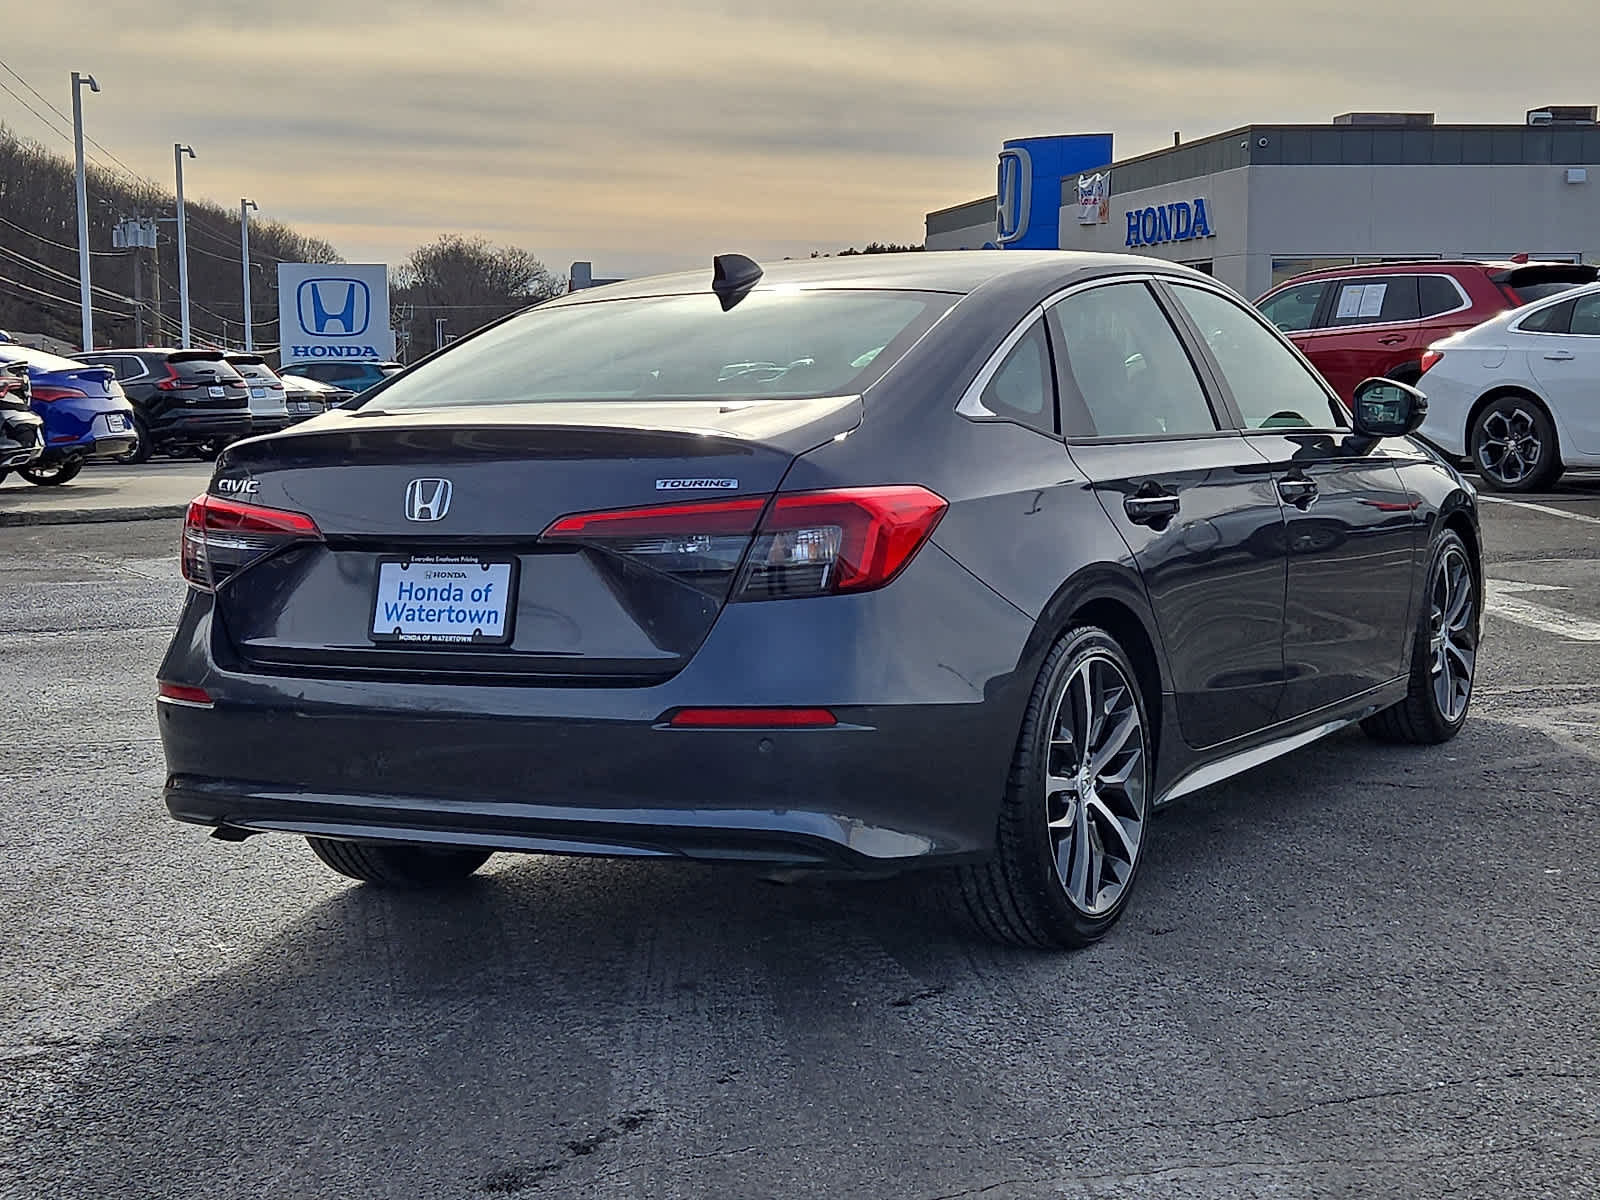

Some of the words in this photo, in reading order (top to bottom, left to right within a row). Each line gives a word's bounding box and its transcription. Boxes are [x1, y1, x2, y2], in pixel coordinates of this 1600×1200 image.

[1125, 198, 1211, 247] HONDA
[291, 345, 380, 358] HONDA
[218, 479, 259, 493] CIVIC
[660, 479, 734, 489] TOURING
[433, 571, 467, 579] HONDA
[398, 581, 464, 602] Honda
[470, 583, 494, 602] of
[385, 602, 499, 624] Watertown
